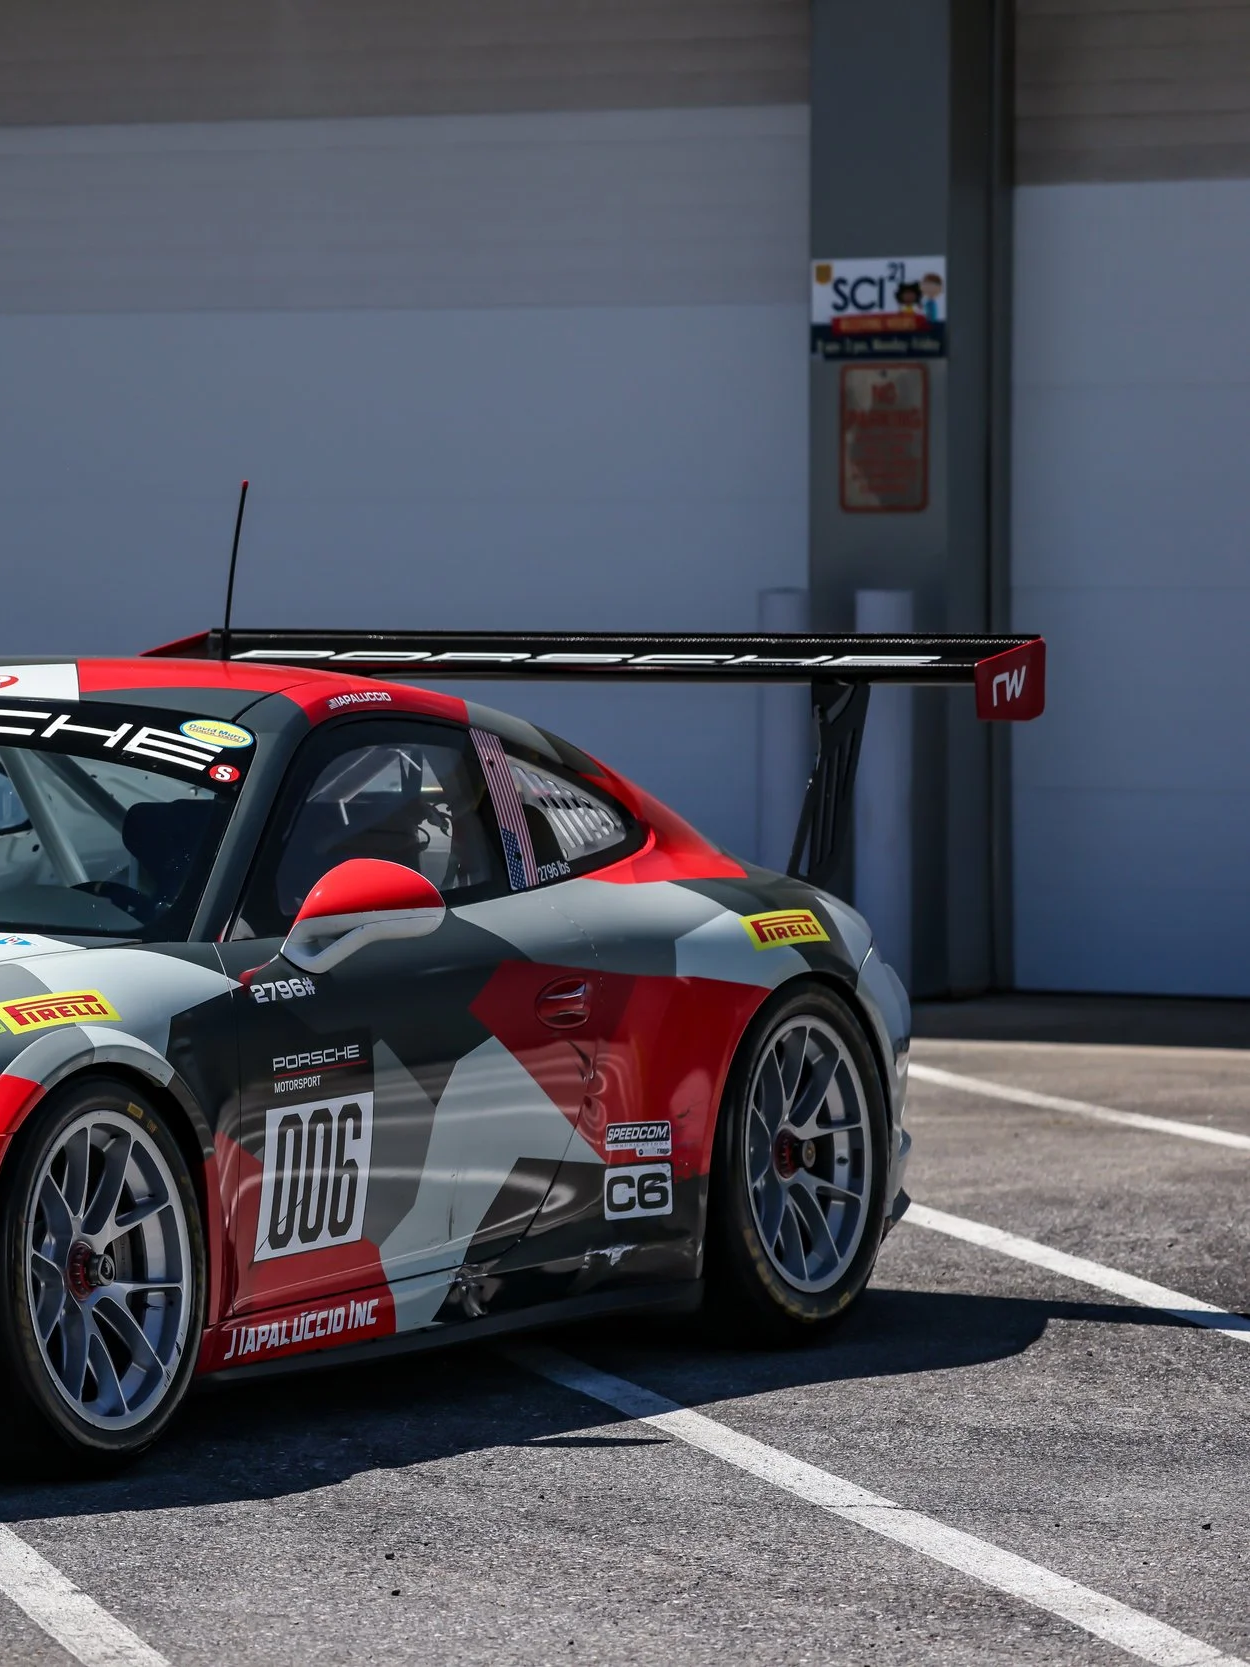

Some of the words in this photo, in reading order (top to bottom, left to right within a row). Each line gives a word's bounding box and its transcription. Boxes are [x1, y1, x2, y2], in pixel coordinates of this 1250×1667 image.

[832, 276, 885, 312] SCI
[230, 650, 942, 666] PORSCHE
[215, 766, 233, 781] S
[537, 862, 559, 882] 2796
[556, 860, 570, 875] lbs
[750, 914, 821, 944] PIRELLI
[250, 976, 316, 1003] 2796#
[2, 994, 109, 1026] PIRELLI
[272, 1044, 360, 1072] PORSCHE
[274, 1075, 321, 1094] MOTORSPORT
[606, 1125, 669, 1142] SPEEDCOM
[268, 1102, 363, 1251] 006
[606, 1172, 669, 1213] C6
